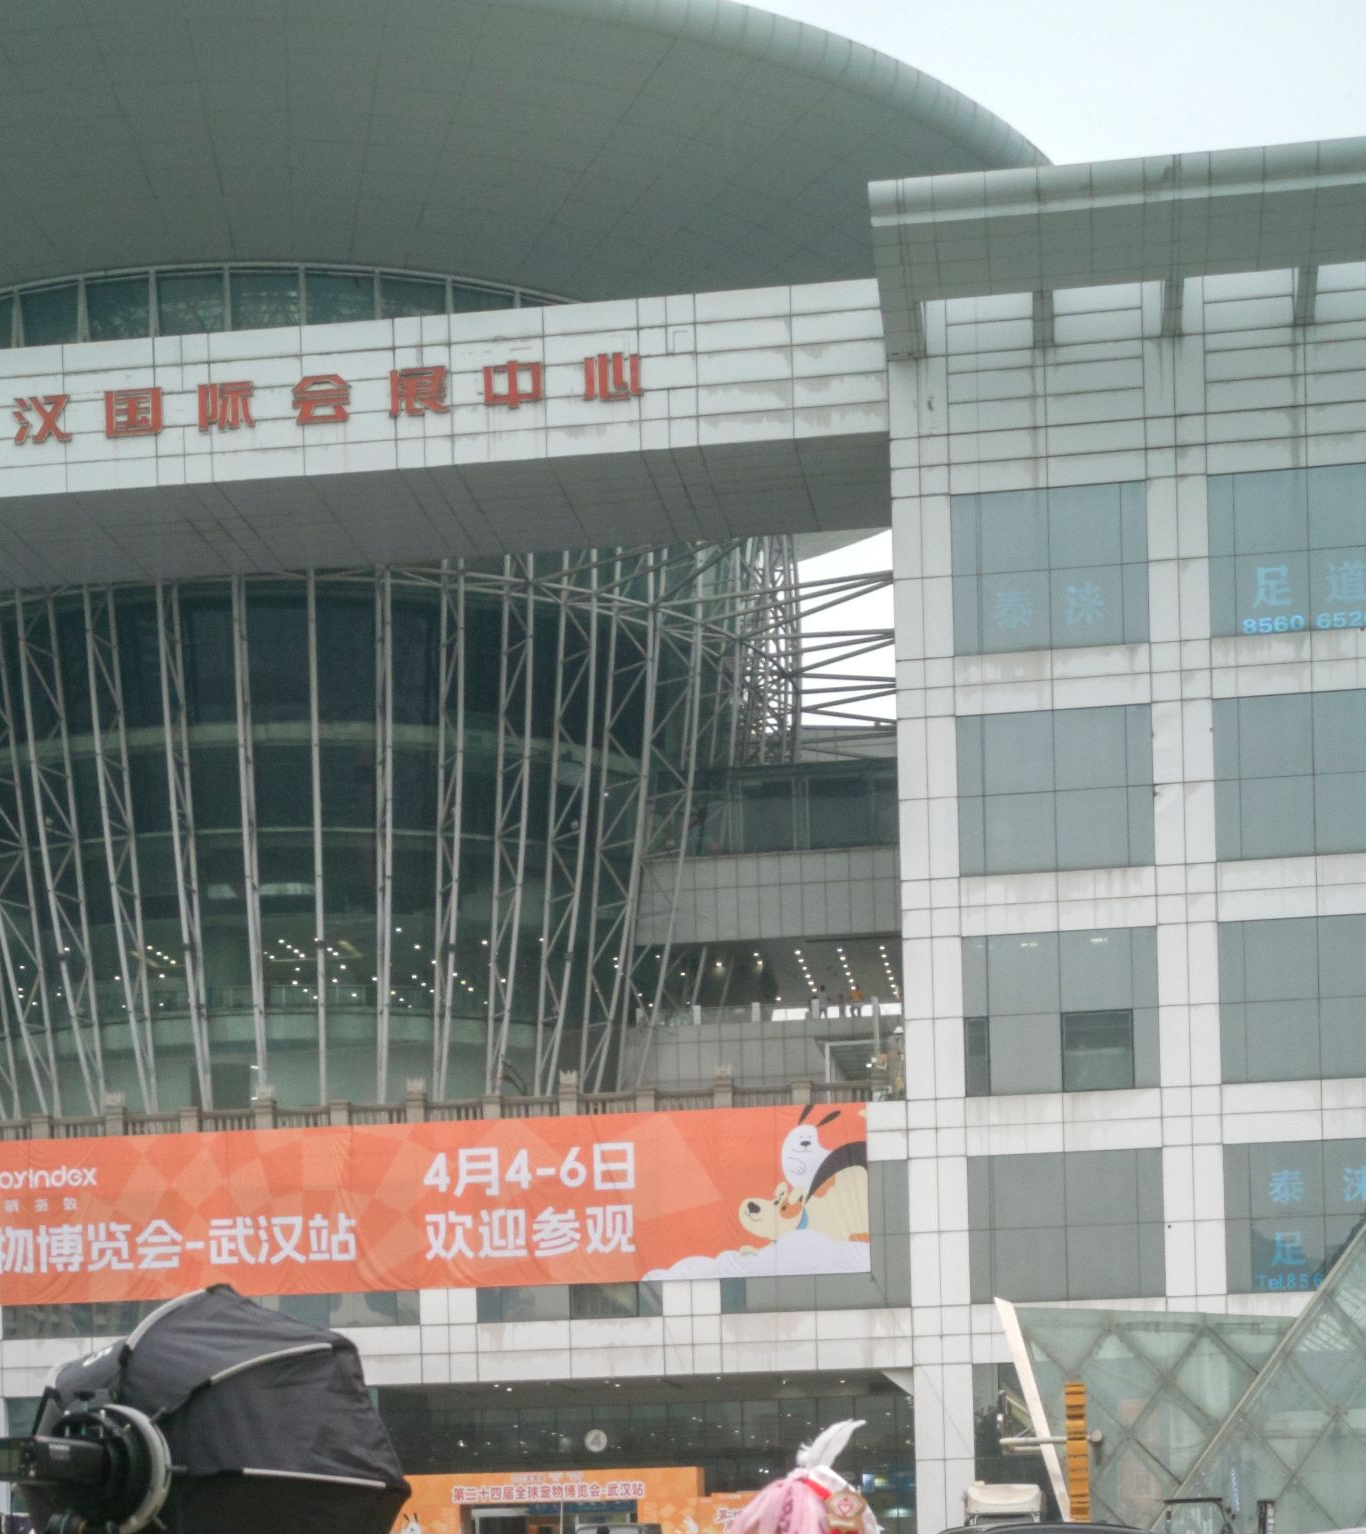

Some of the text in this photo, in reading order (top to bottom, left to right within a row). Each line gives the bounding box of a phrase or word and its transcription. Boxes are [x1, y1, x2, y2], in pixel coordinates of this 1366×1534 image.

[1242, 614, 1305, 635] 8560
[422, 1141, 636, 1198] 4月4-6日
[424, 1203, 636, 1261] 欢迎参观
